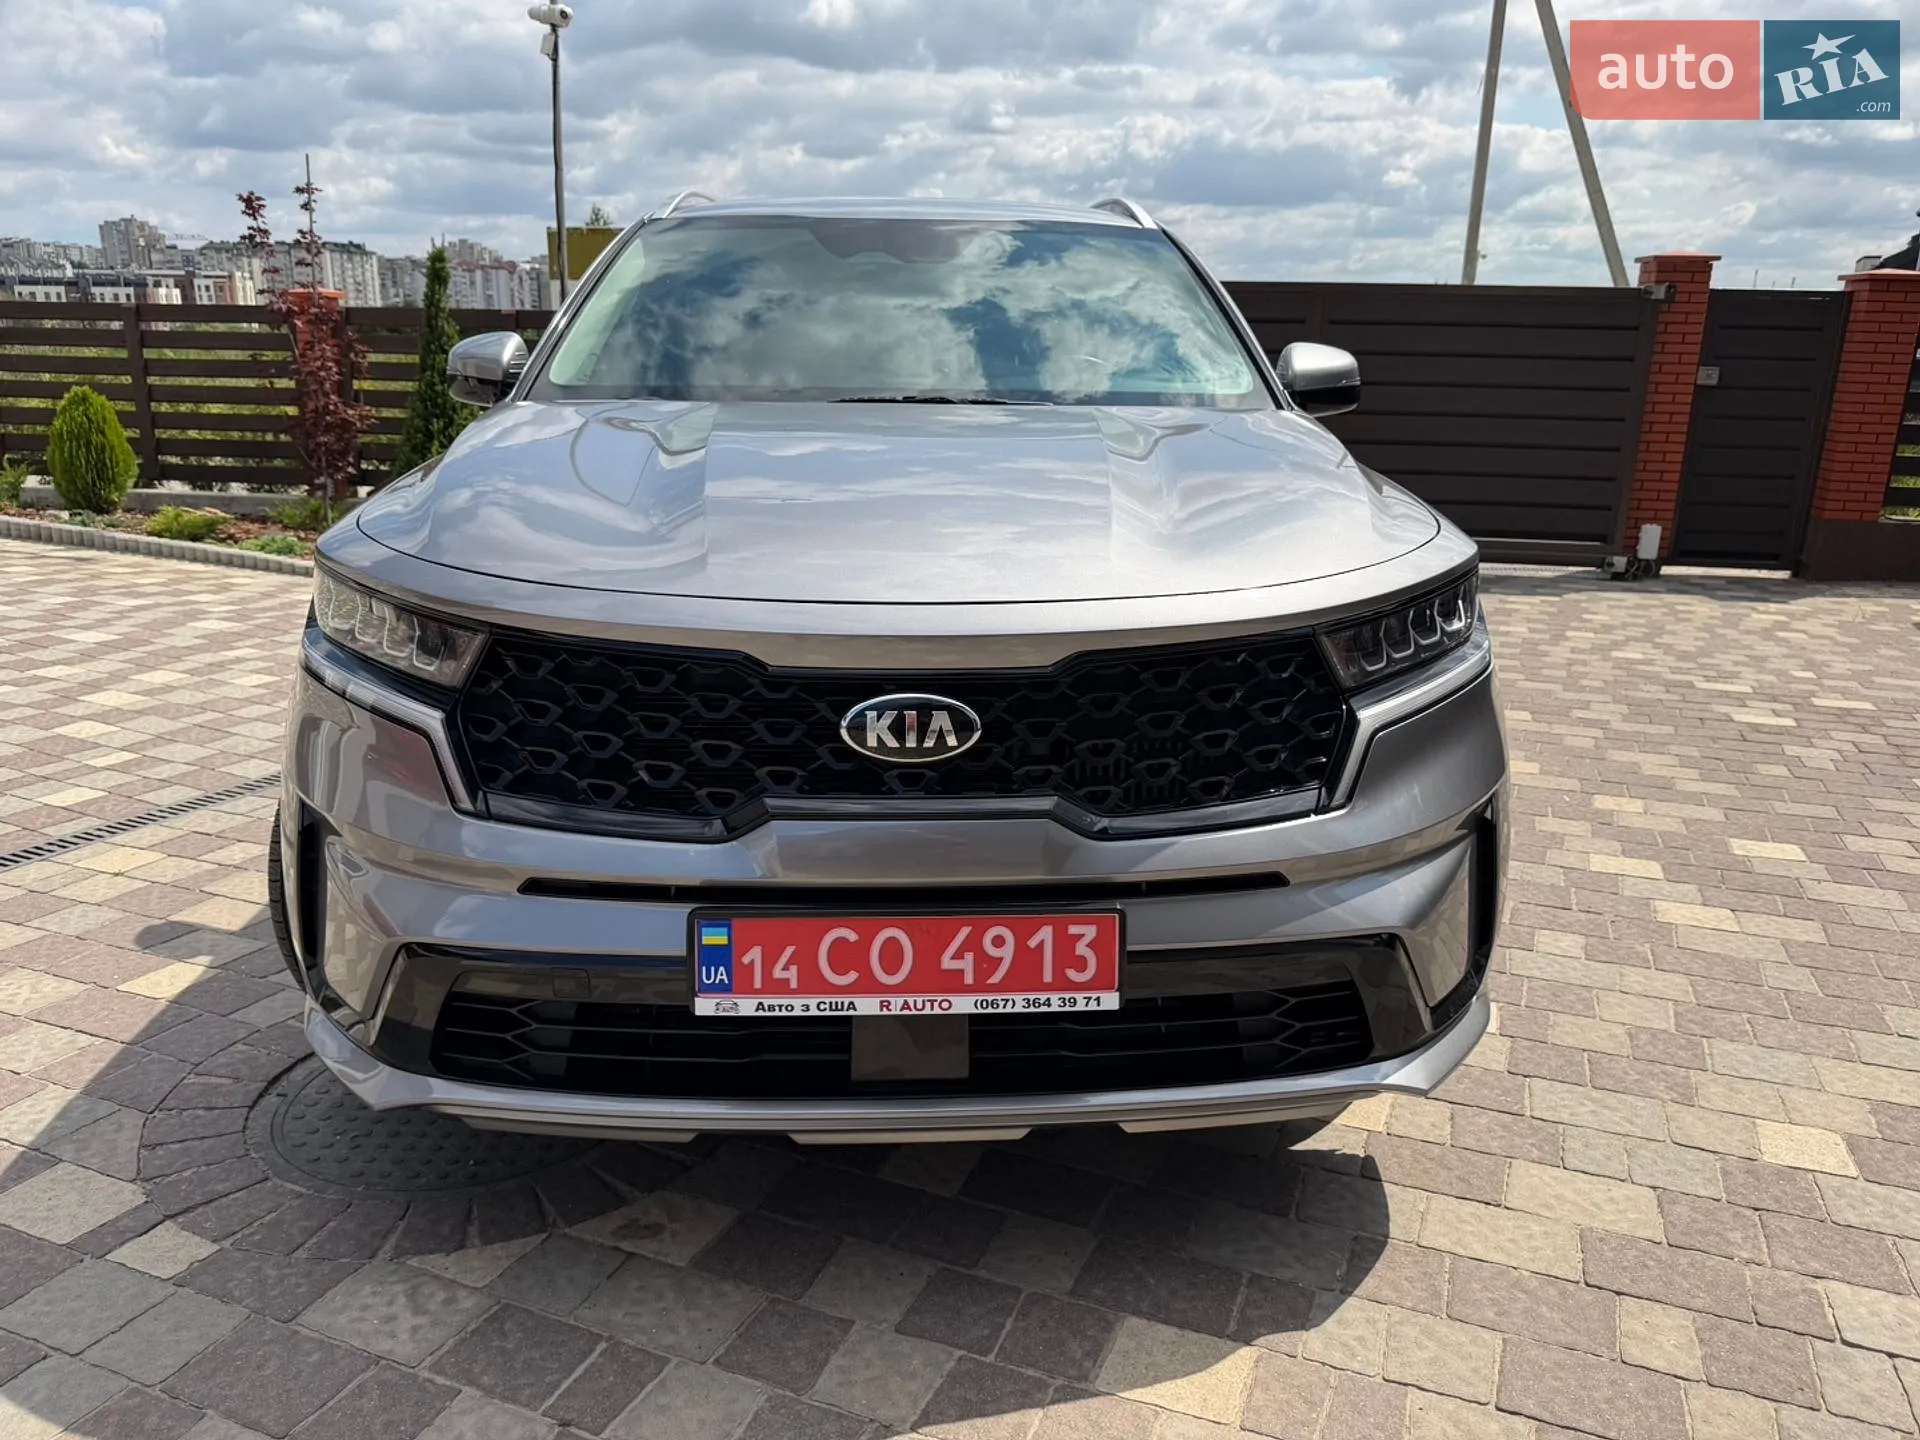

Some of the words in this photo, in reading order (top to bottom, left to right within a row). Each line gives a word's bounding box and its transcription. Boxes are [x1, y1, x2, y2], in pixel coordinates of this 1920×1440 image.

[864, 710, 959, 748] KIA
[741, 945, 798, 989] 14
[817, 926, 914, 986] CO
[940, 924, 1098, 985] 4913
[702, 966, 728, 984] UA
[816, 1001, 858, 1012] США
[974, 998, 1016, 1010] (067)
[1022, 997, 1052, 1009] 364
[1058, 996, 1077, 1008] 39
[1083, 996, 1101, 1008] 71
